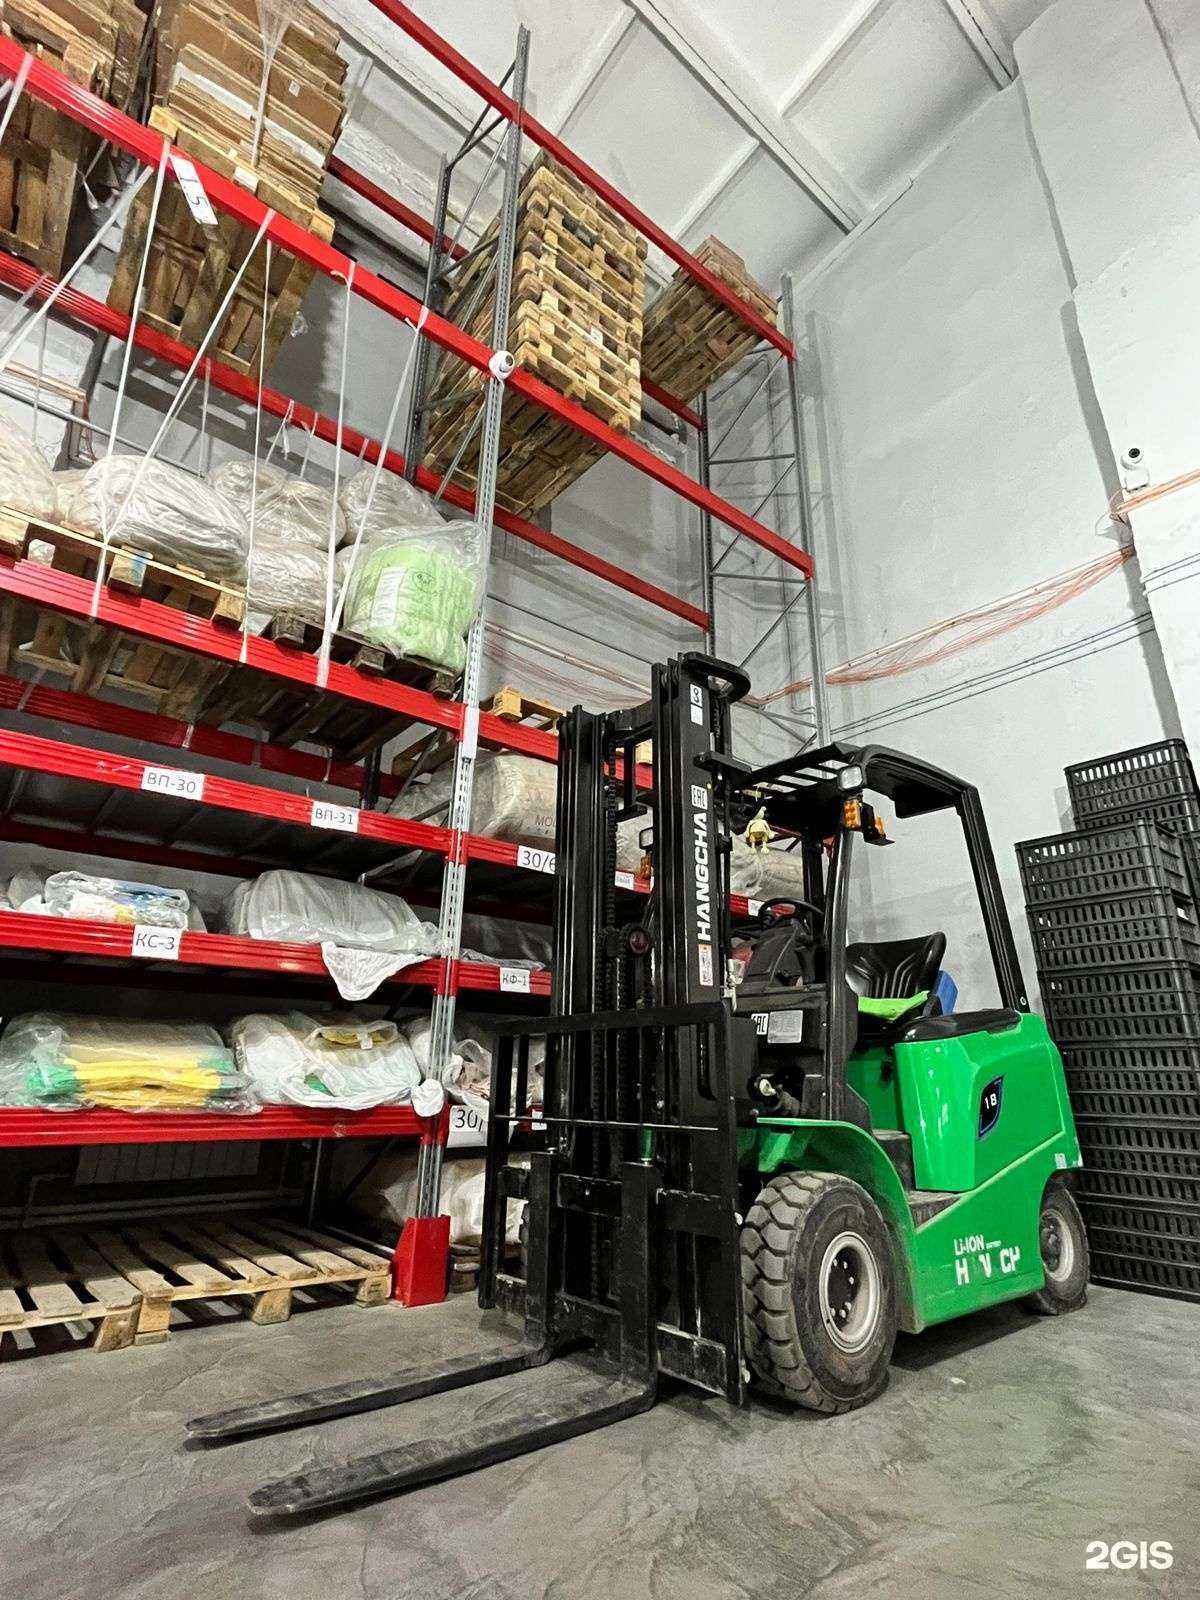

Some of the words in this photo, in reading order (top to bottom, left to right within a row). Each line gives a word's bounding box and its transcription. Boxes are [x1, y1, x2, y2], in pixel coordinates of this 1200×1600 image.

[147, 772, 196, 793] ВП-30
[315, 808, 353, 825] ВП-31
[694, 812, 711, 941] HANGCHA
[136, 933, 175, 950] КС-3
[502, 973, 527, 986] КФ-1
